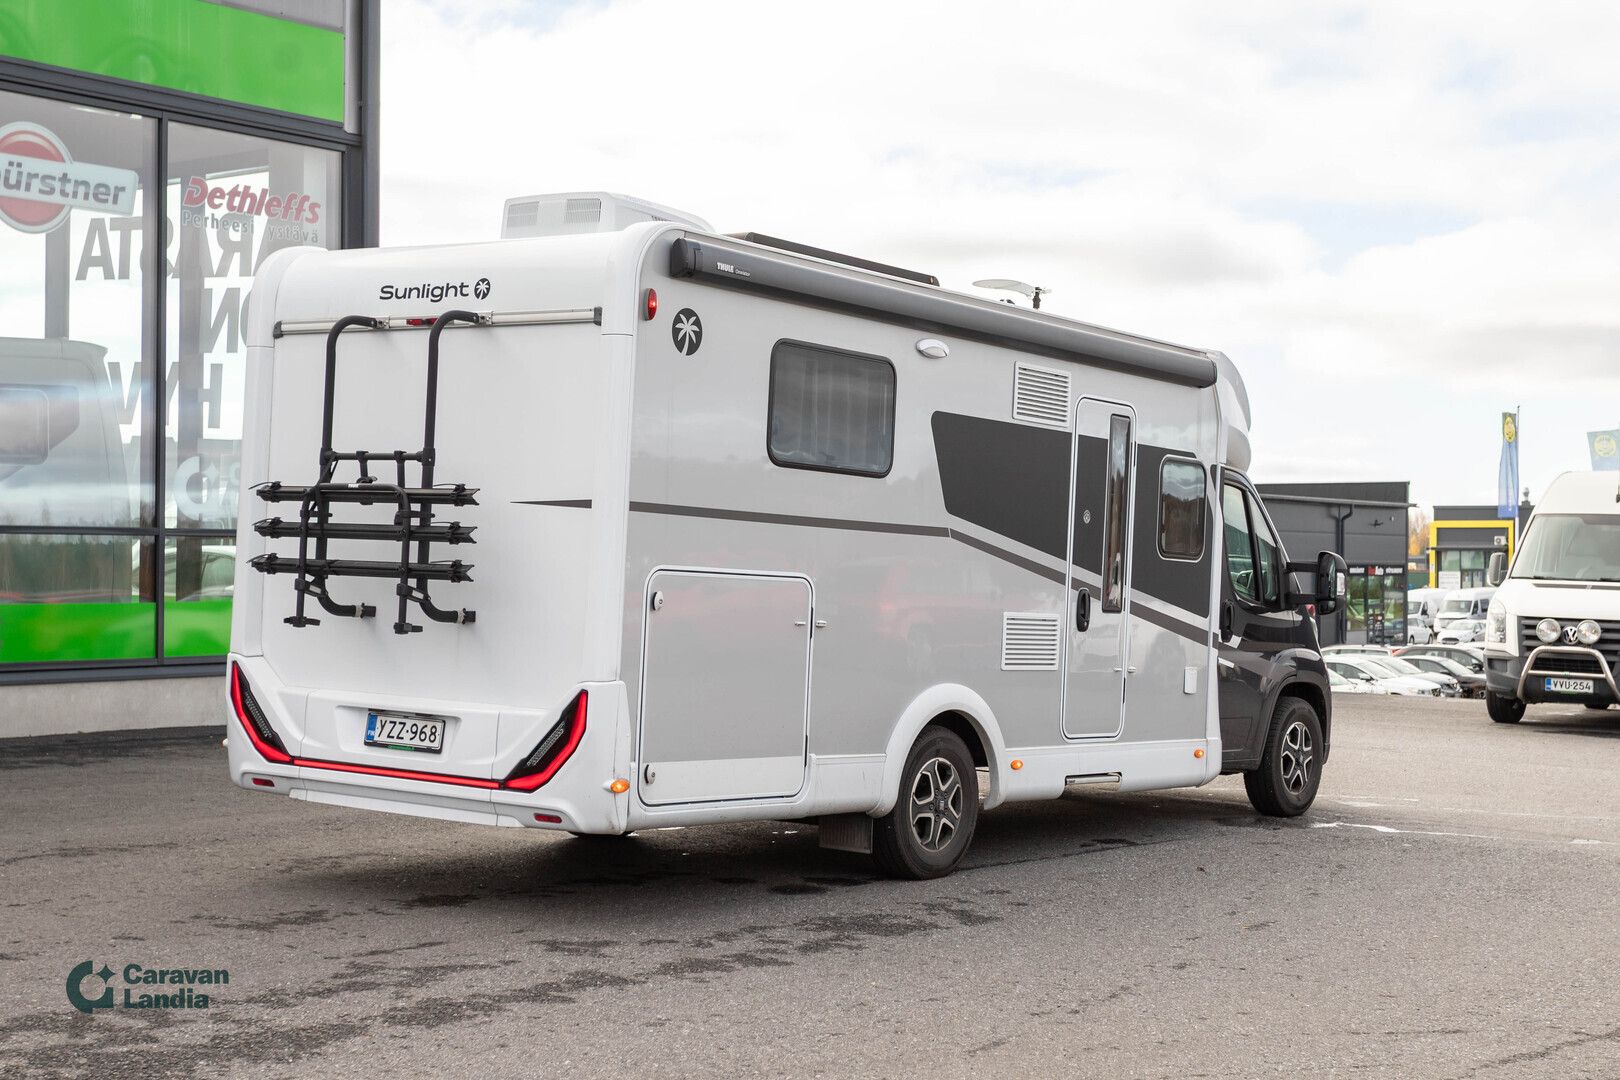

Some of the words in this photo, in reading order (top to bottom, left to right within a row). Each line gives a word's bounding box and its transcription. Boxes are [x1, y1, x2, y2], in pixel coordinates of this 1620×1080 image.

[0, 161, 126, 205] ürstner
[184, 176, 321, 224] Dethleffs
[717, 262, 734, 273] THULE
[380, 282, 469, 303] Sunlight
[1553, 680, 1591, 691] VVU-254
[378, 719, 438, 743] YZZ-968
